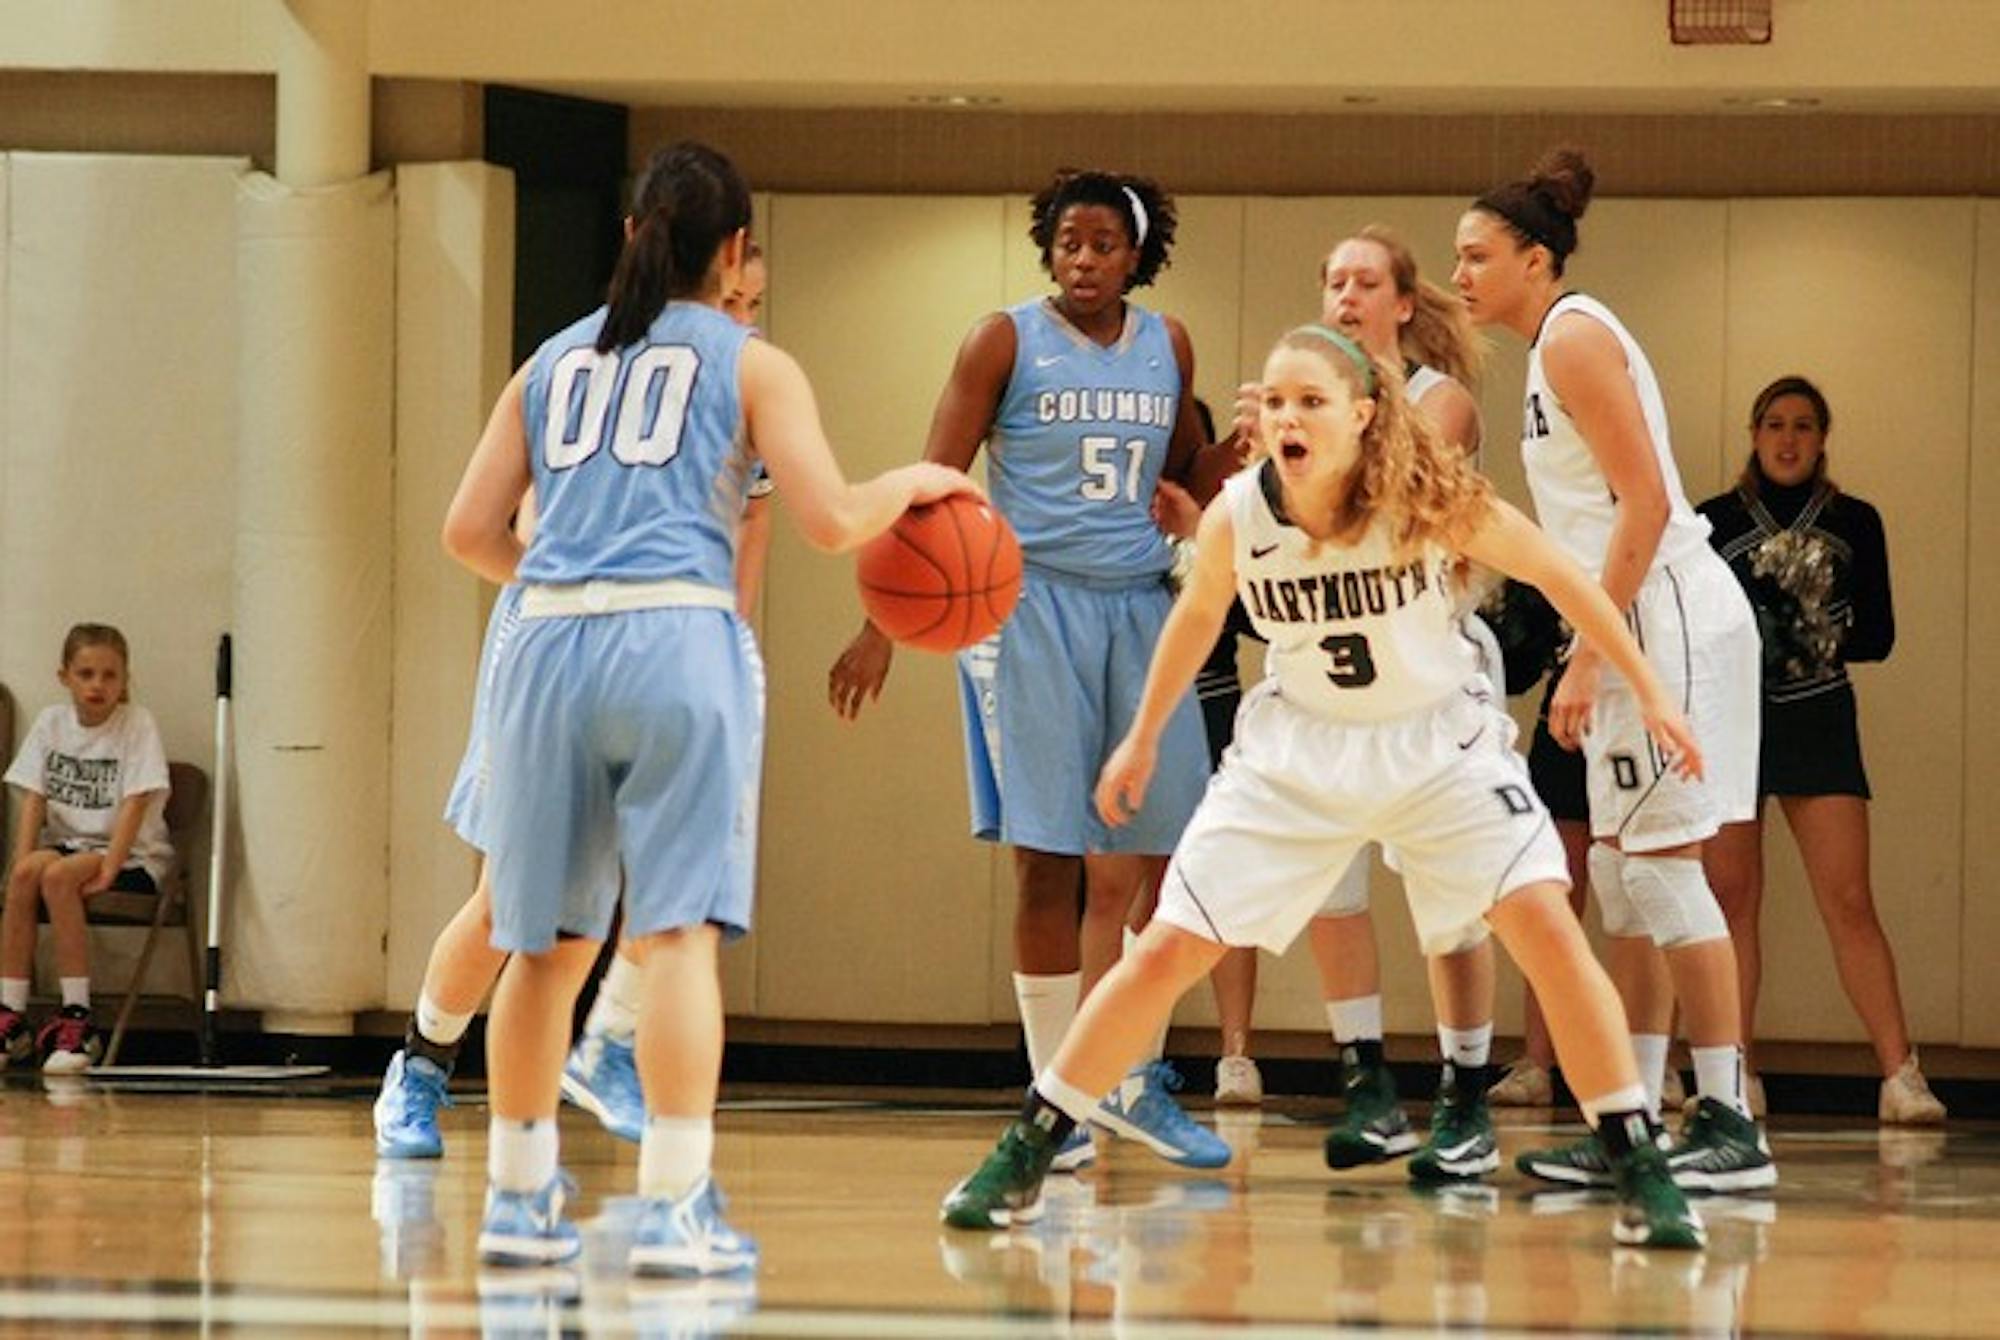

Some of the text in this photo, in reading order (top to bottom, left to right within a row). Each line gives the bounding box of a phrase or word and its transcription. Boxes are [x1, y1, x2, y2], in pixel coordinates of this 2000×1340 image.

[544, 344, 700, 472] 00
[1079, 435, 1148, 503] 51
[1318, 633, 1378, 689] 3
[1495, 784, 1533, 815] D
[1610, 755, 1639, 789] D
